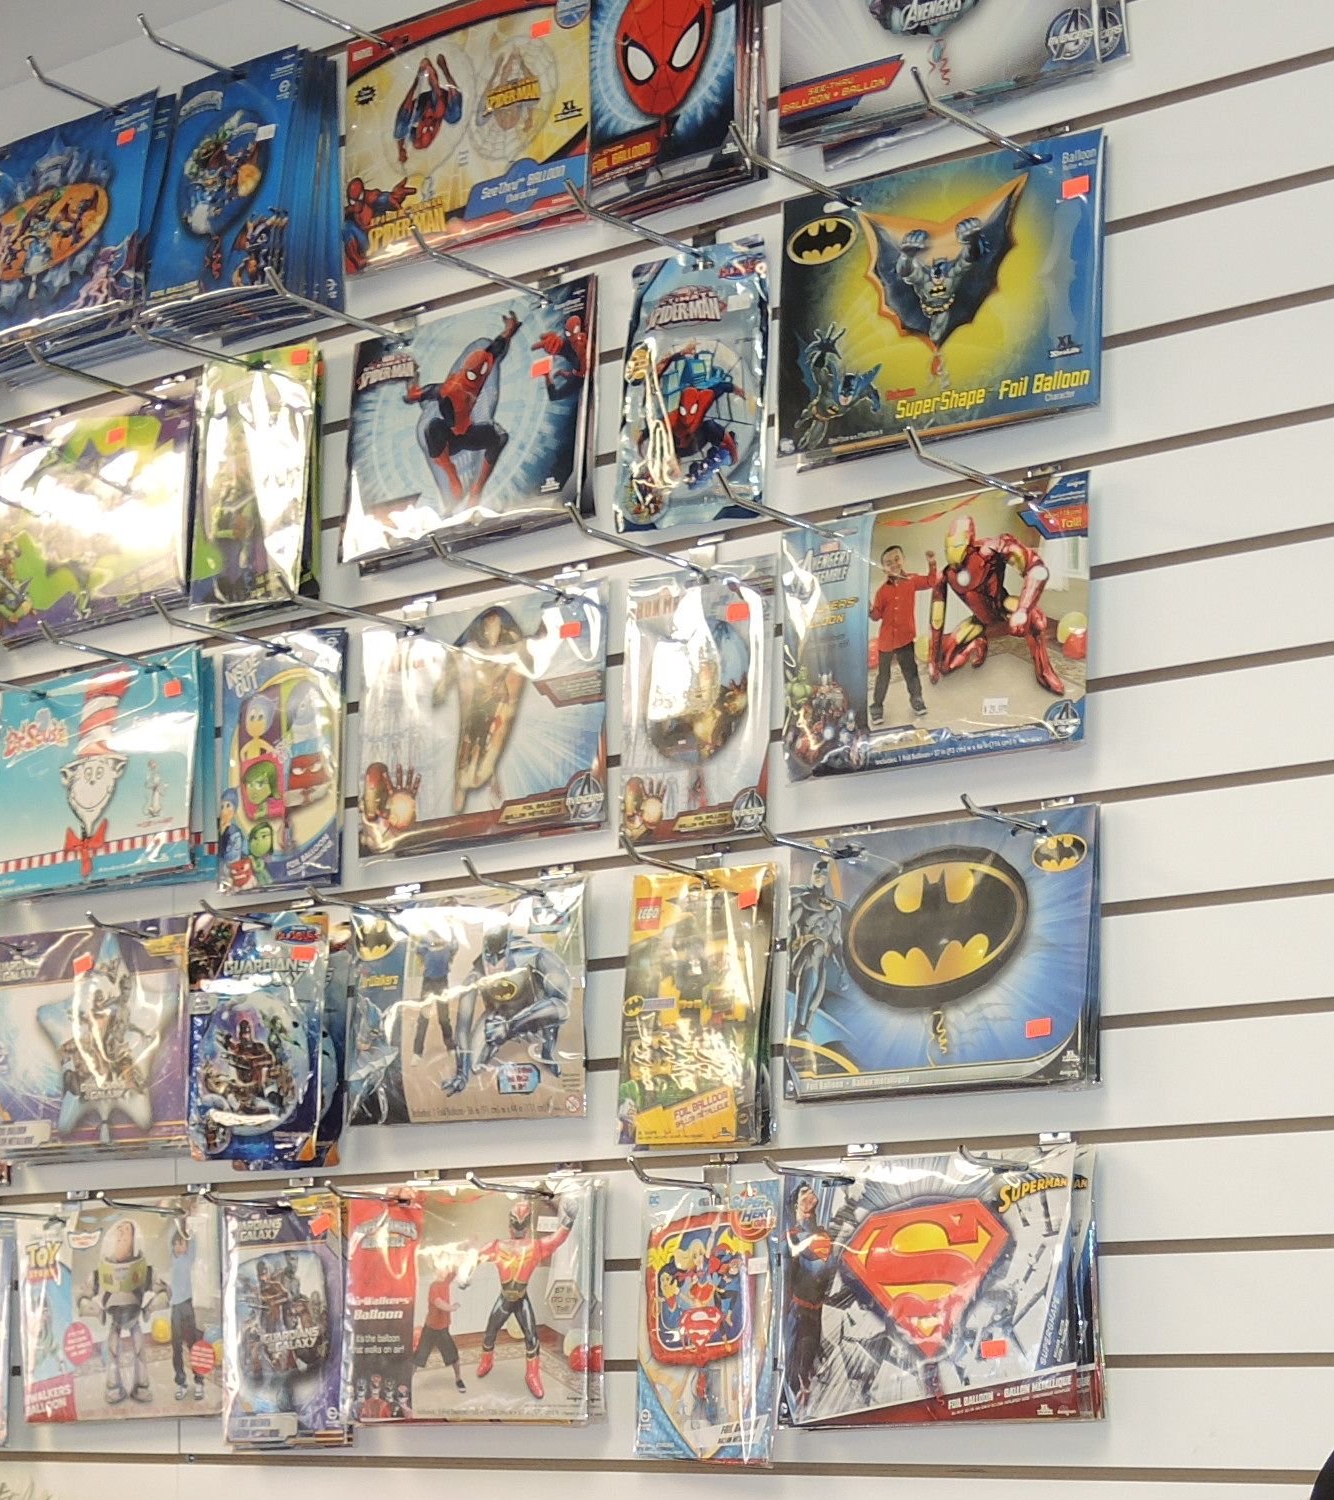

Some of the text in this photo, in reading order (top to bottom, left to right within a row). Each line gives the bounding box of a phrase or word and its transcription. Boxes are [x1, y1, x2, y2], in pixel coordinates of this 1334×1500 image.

[781, 77, 887, 113] BALLOON BALLON
[366, 206, 447, 256] SPIDER-MAN
[646, 298, 722, 333] SPIDER-MAN
[895, 387, 986, 419] SuperShape
[998, 376, 1029, 400] Foil
[1032, 369, 1091, 394] Balloon
[225, 656, 261, 689] INSIDE
[234, 668, 259, 698] OUT
[638, 906, 660, 921] LEGO
[224, 959, 311, 977] GUARDIANS
[998, 1176, 1067, 1213] SUPERMAN
[741, 1208, 774, 1226] HERO
[240, 1228, 280, 1242] GALAXY
[26, 1240, 62, 1268] TOY
[353, 1309, 404, 1321] Balloon
[263, 1326, 320, 1345] GUARDIANS
[275, 1335, 319, 1353] GALAXY
